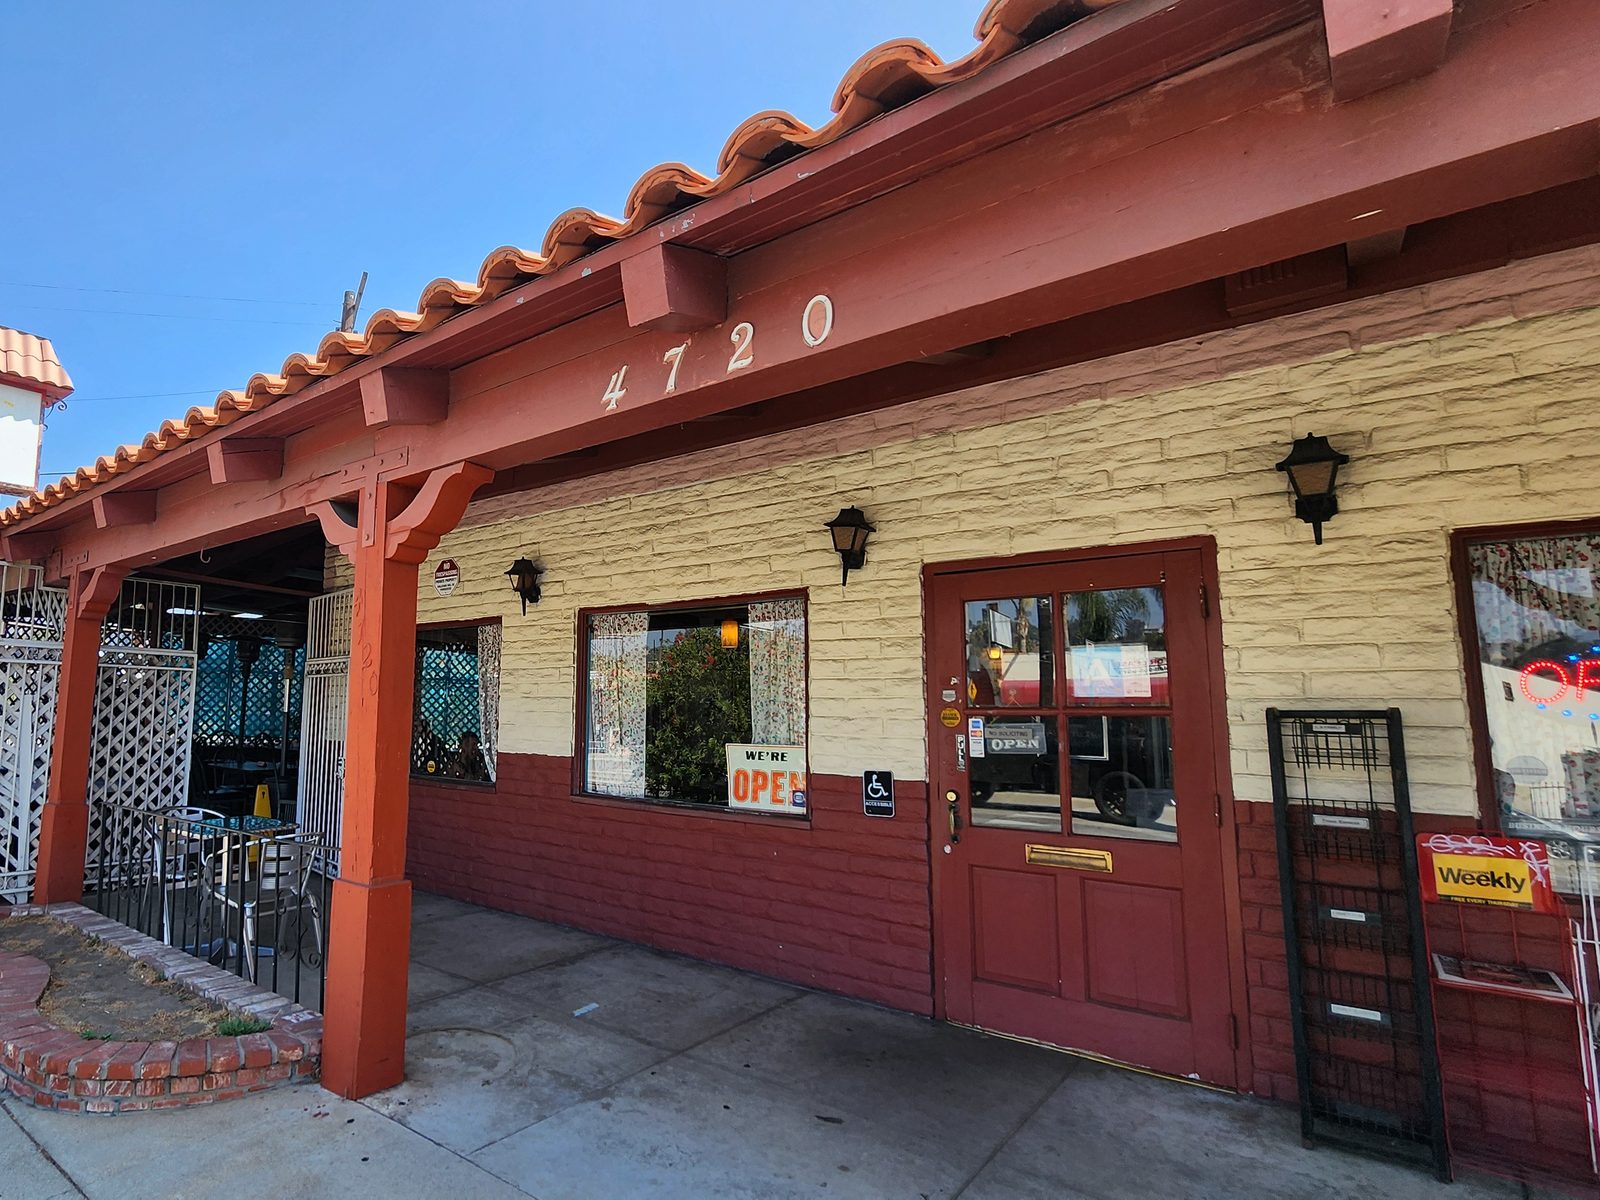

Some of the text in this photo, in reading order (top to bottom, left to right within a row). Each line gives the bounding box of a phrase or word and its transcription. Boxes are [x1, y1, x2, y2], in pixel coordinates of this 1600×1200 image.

[601, 294, 833, 411] 4720
[991, 738, 1039, 751] OPEN
[745, 750, 788, 762] WE'RE
[1438, 866, 1526, 893] Weekly
